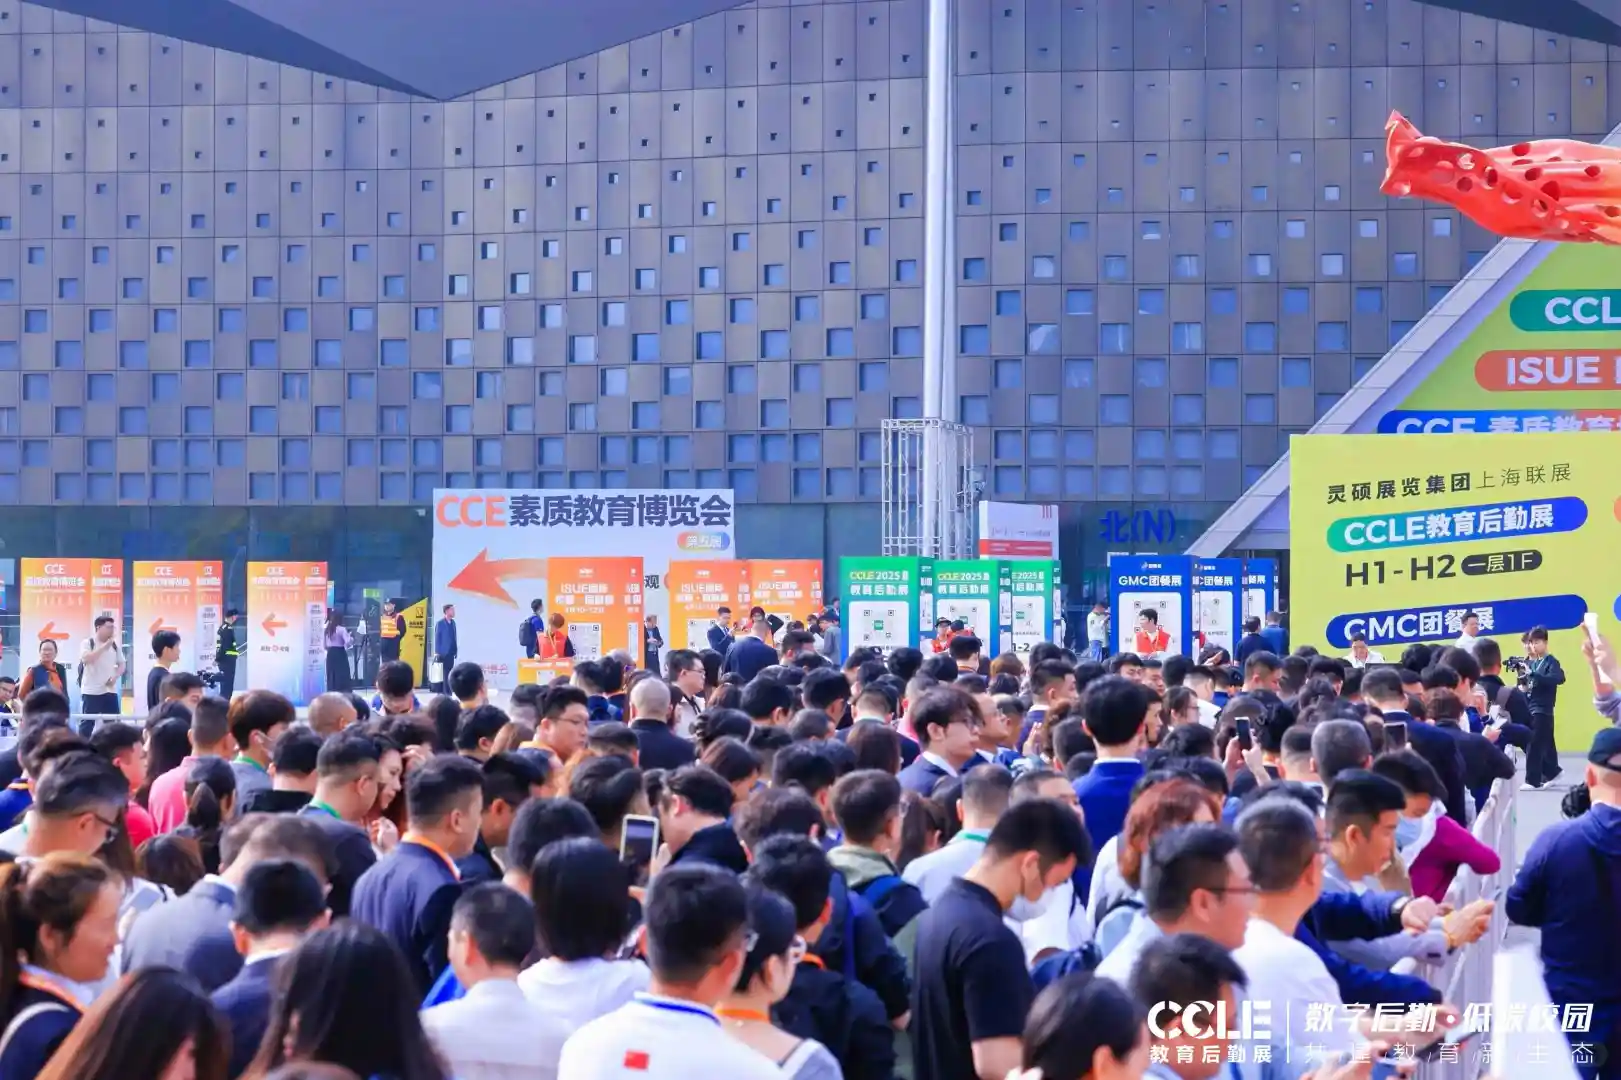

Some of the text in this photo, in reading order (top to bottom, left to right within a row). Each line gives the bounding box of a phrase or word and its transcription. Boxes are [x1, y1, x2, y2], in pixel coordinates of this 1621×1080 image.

[1507, 356, 1602, 385] ISUE
[1344, 504, 1554, 546] CCLE教育后勤展
[876, 571, 900, 581] 2025
